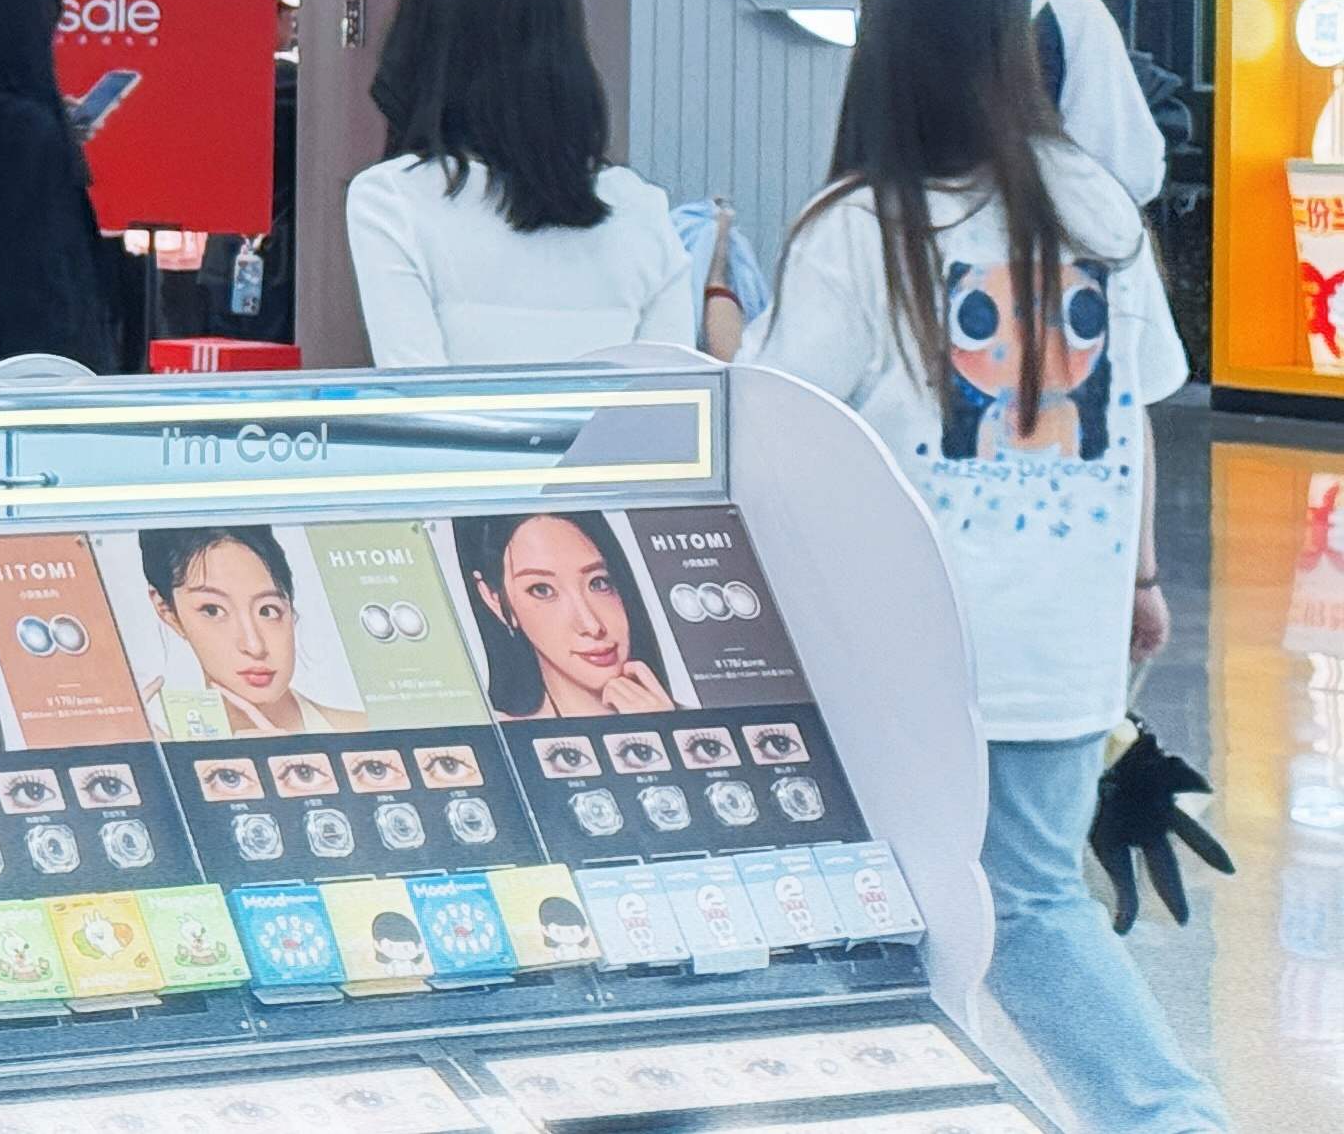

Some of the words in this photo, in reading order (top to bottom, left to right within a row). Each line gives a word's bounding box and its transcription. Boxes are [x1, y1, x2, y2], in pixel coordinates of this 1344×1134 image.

[163, 427, 221, 465] I'm
[236, 422, 328, 463] Cool
[650, 532, 733, 552] HITOMI
[328, 547, 415, 568] HITOMI
